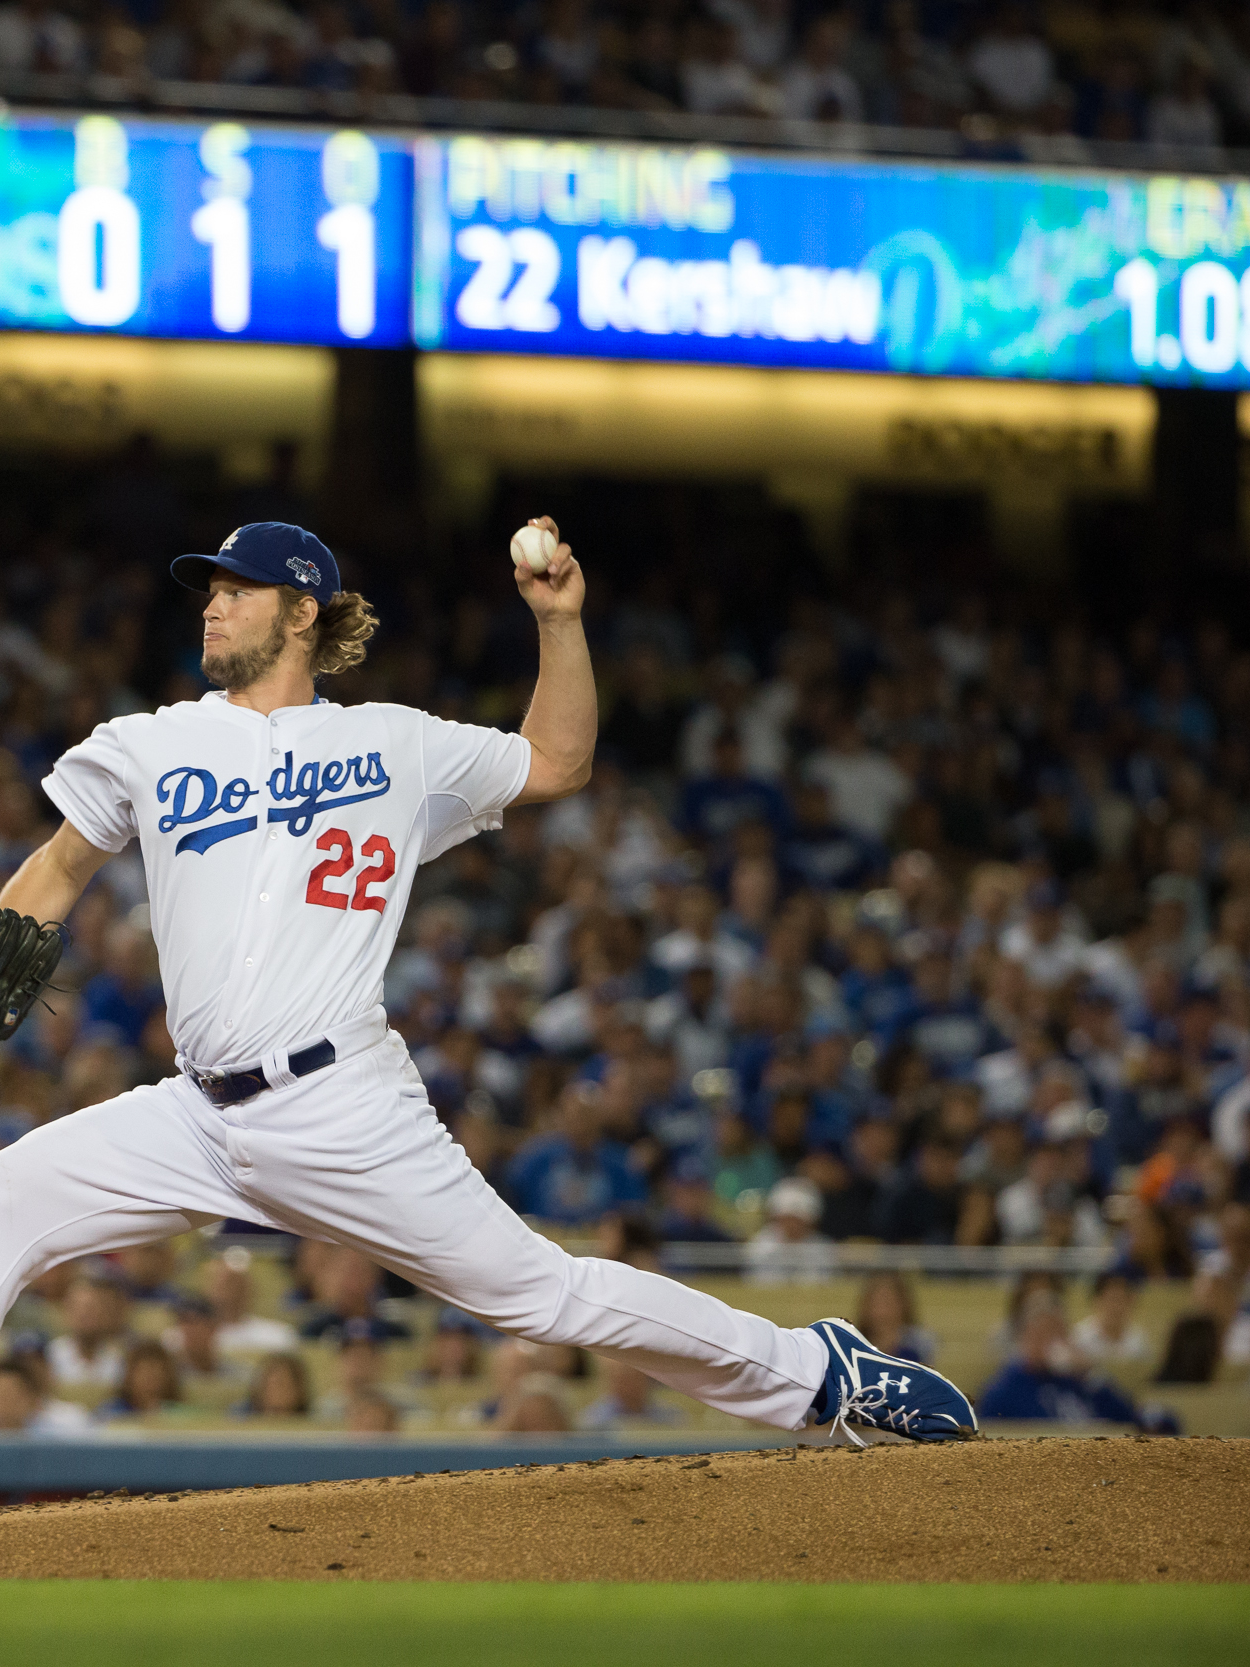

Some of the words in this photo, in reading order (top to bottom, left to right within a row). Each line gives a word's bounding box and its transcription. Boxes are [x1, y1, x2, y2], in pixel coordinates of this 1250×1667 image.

[199, 122, 252, 200] S
[448, 135, 735, 233] PITCHING
[59, 185, 141, 326] 0
[192, 196, 251, 333] 1
[316, 203, 377, 338] 1
[455, 224, 561, 332] 22
[577, 234, 882, 344] Kershaw
[1113, 256, 1250, 374] 1.0
[157, 750, 391, 837] Dodgers
[305, 827, 396, 915] 22
